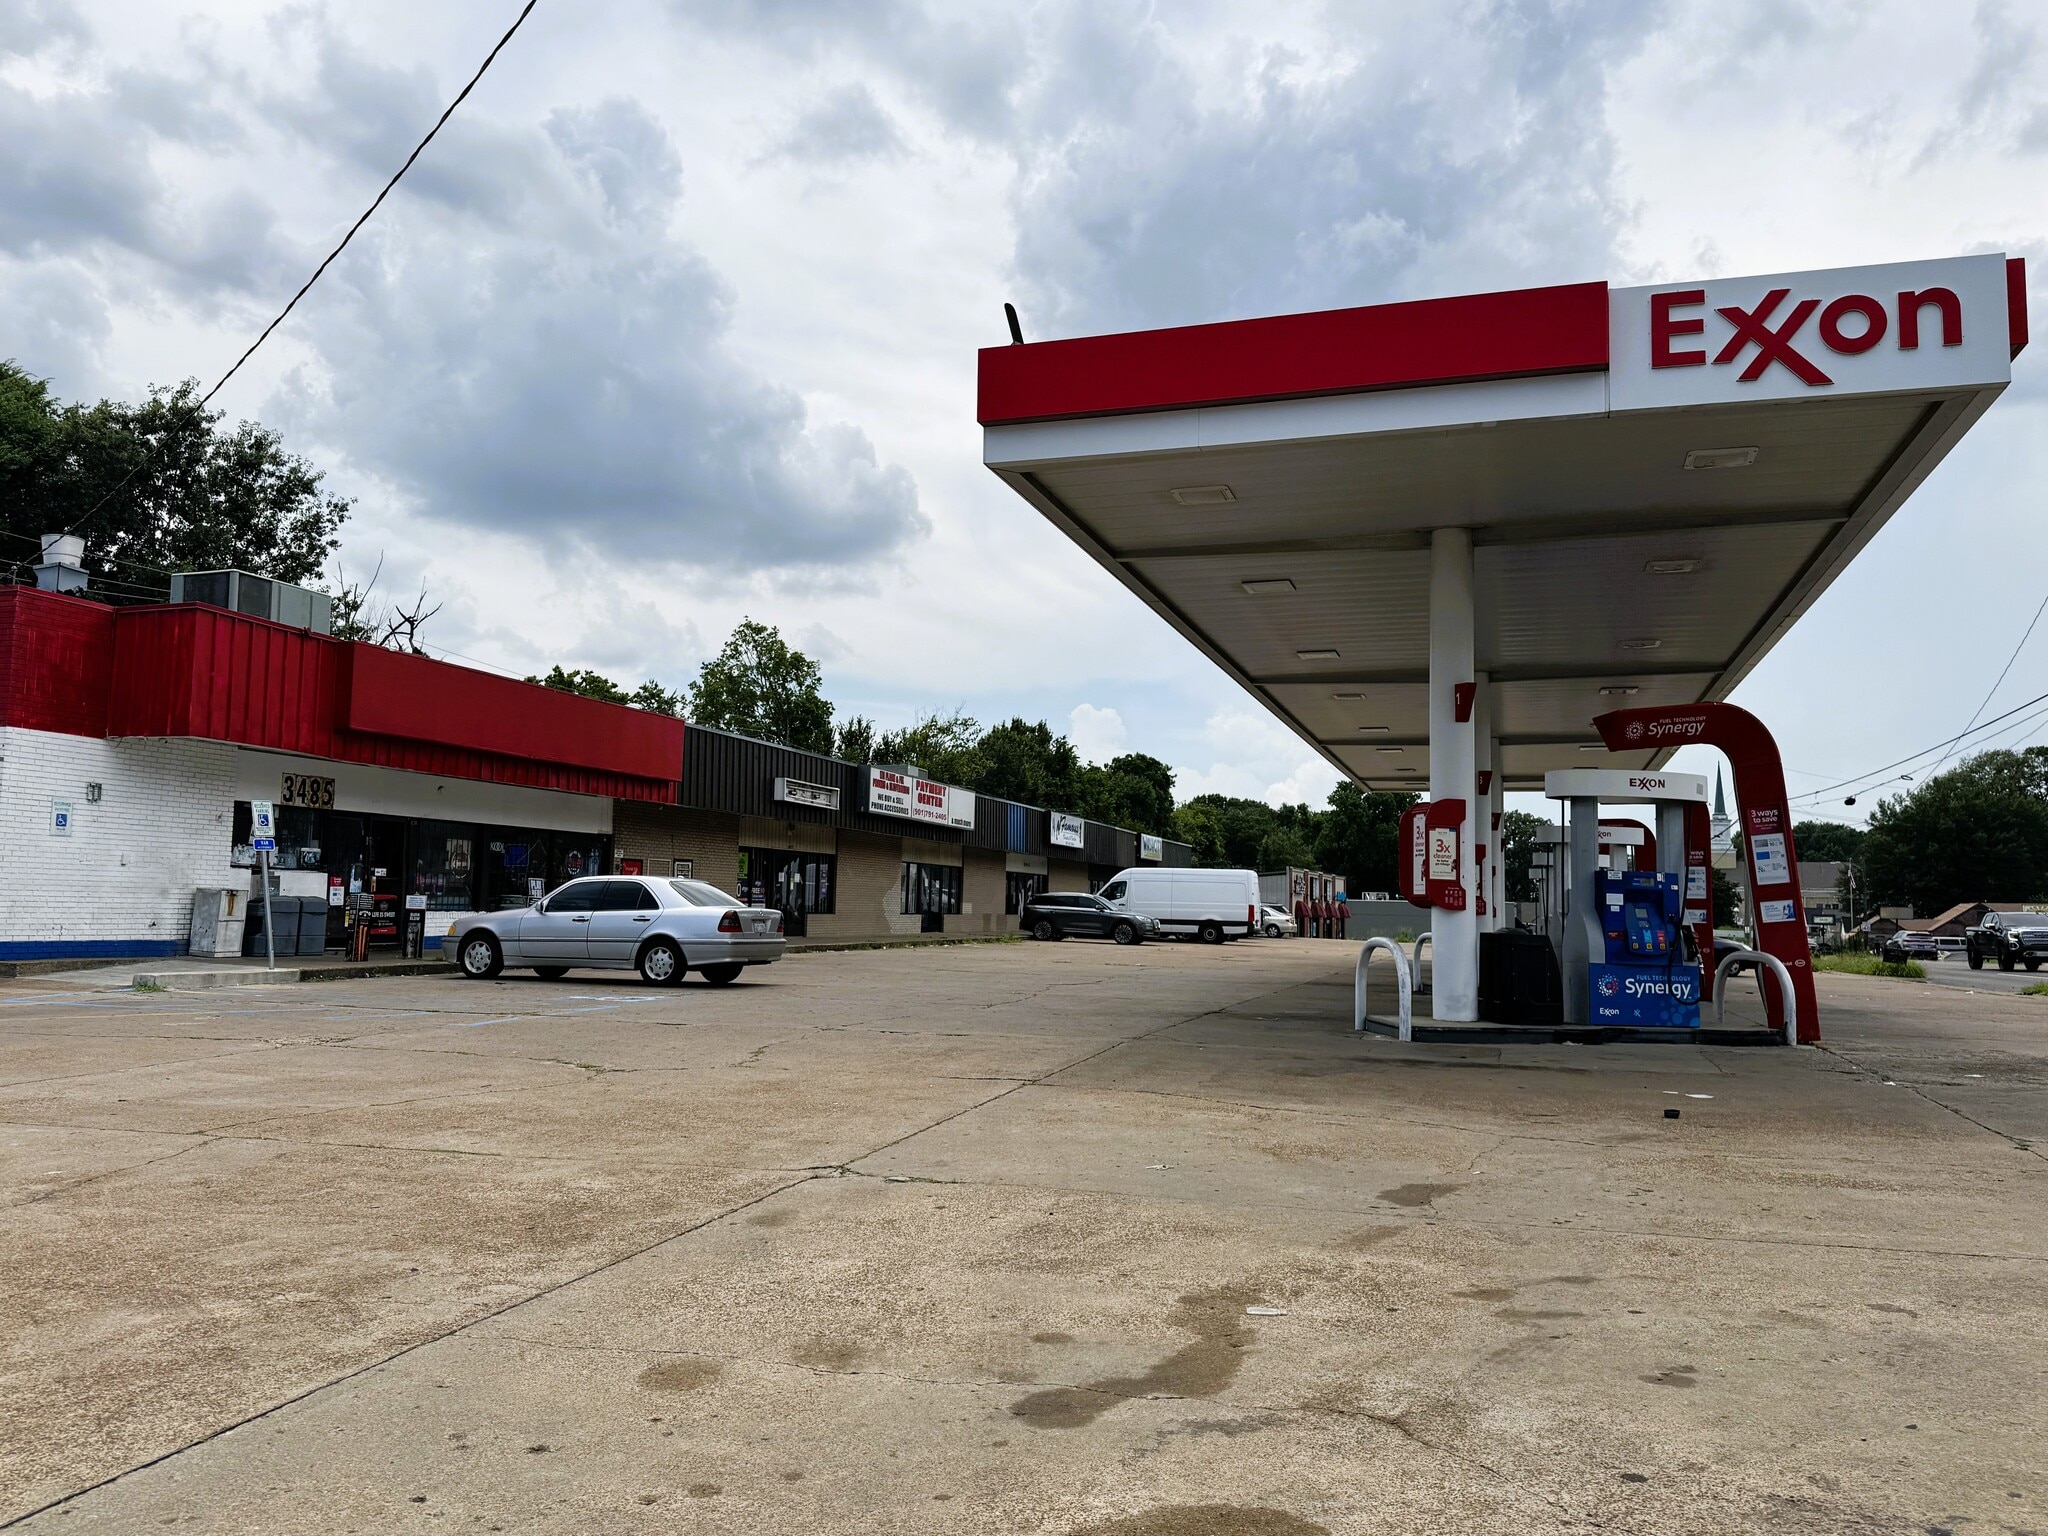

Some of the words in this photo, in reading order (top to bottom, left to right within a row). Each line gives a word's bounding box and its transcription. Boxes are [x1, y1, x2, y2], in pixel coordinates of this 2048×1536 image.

[1650, 286, 1963, 386] Exxon
[1456, 692, 1460, 705] 1
[1648, 722, 1705, 738] Synergy
[283, 776, 333, 806] 3485
[915, 780, 947, 797] PAYMENT
[1629, 777, 1666, 791] EXXON
[877, 793, 884, 801] WE
[896, 797, 904, 805] SELL
[917, 792, 943, 808] CENTER
[871, 802, 884, 811] PHONE
[884, 803, 909, 815] ACCESSORIES
[1757, 809, 1778, 817] ways
[1436, 839, 1451, 853] 3x
[1599, 1008, 1619, 1017] Exxon
